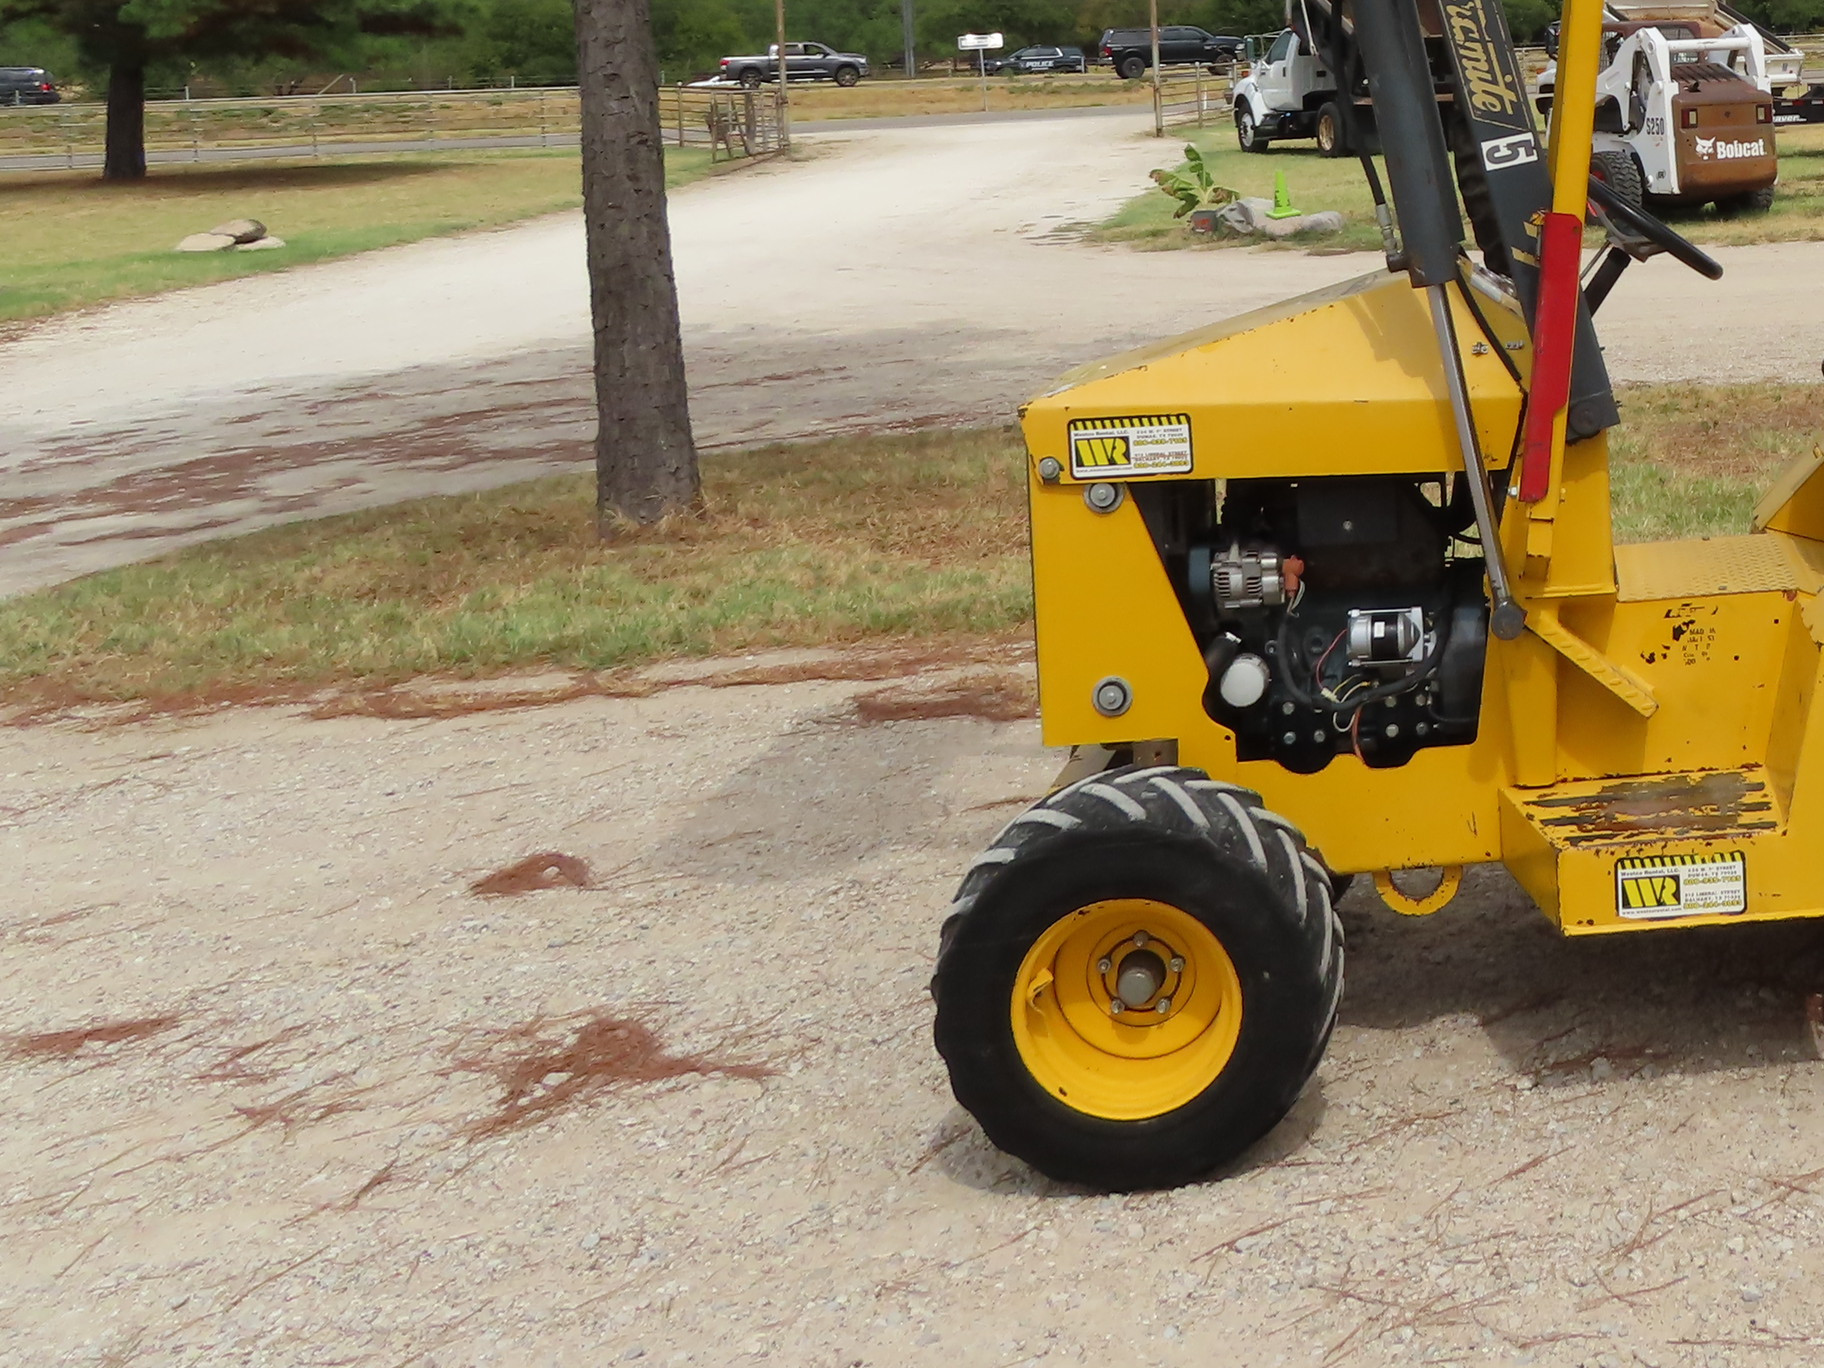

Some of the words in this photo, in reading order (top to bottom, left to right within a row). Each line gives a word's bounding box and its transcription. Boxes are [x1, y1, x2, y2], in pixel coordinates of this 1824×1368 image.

[1646, 117, 1664, 135] S250
[1486, 139, 1535, 165] 5
[1716, 139, 1764, 159] Bobcat
